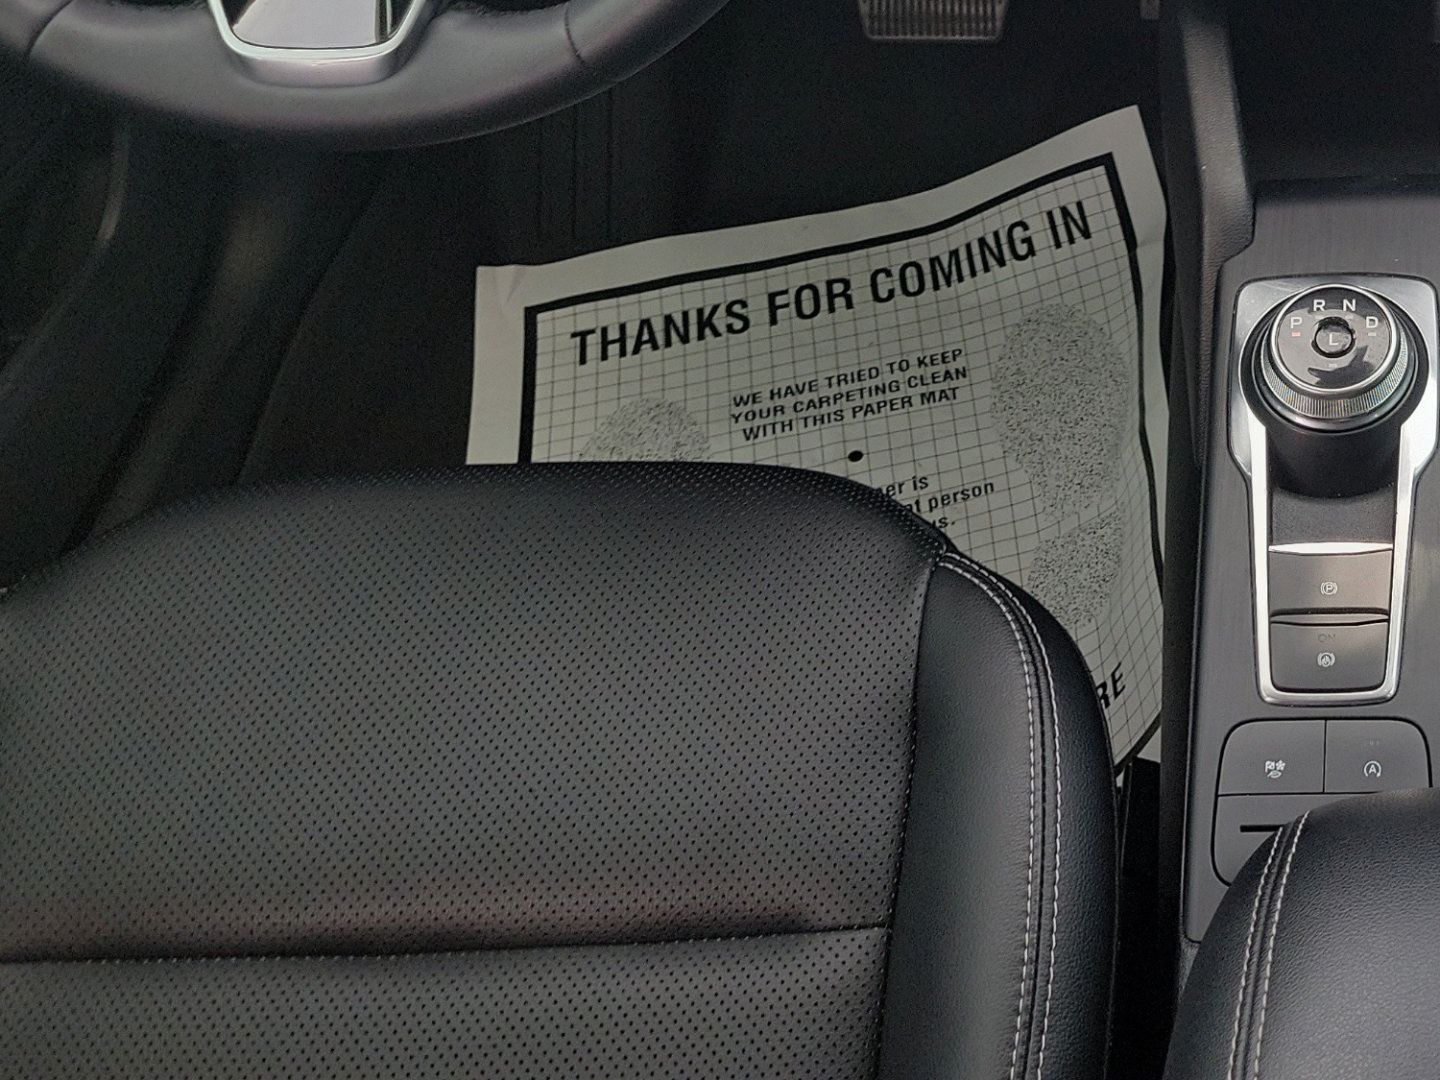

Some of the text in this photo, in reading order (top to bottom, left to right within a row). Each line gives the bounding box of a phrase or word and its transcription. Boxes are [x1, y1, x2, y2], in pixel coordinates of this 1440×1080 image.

[570, 200, 1094, 366] THANKS FOR COMING IN
[1313, 299, 1326, 312] R
[1343, 299, 1356, 312] N
[1290, 317, 1303, 329] P
[1366, 316, 1379, 329] D
[1329, 334, 1339, 346] L
[733, 348, 963, 407] WE HAVE TRIED TO KEEP
[730, 366, 968, 424] YOUR CARPETING CLEAN
[742, 386, 960, 442] WITH THIS PAPER MAT
[912, 475, 929, 491] is
[928, 482, 995, 513] person
